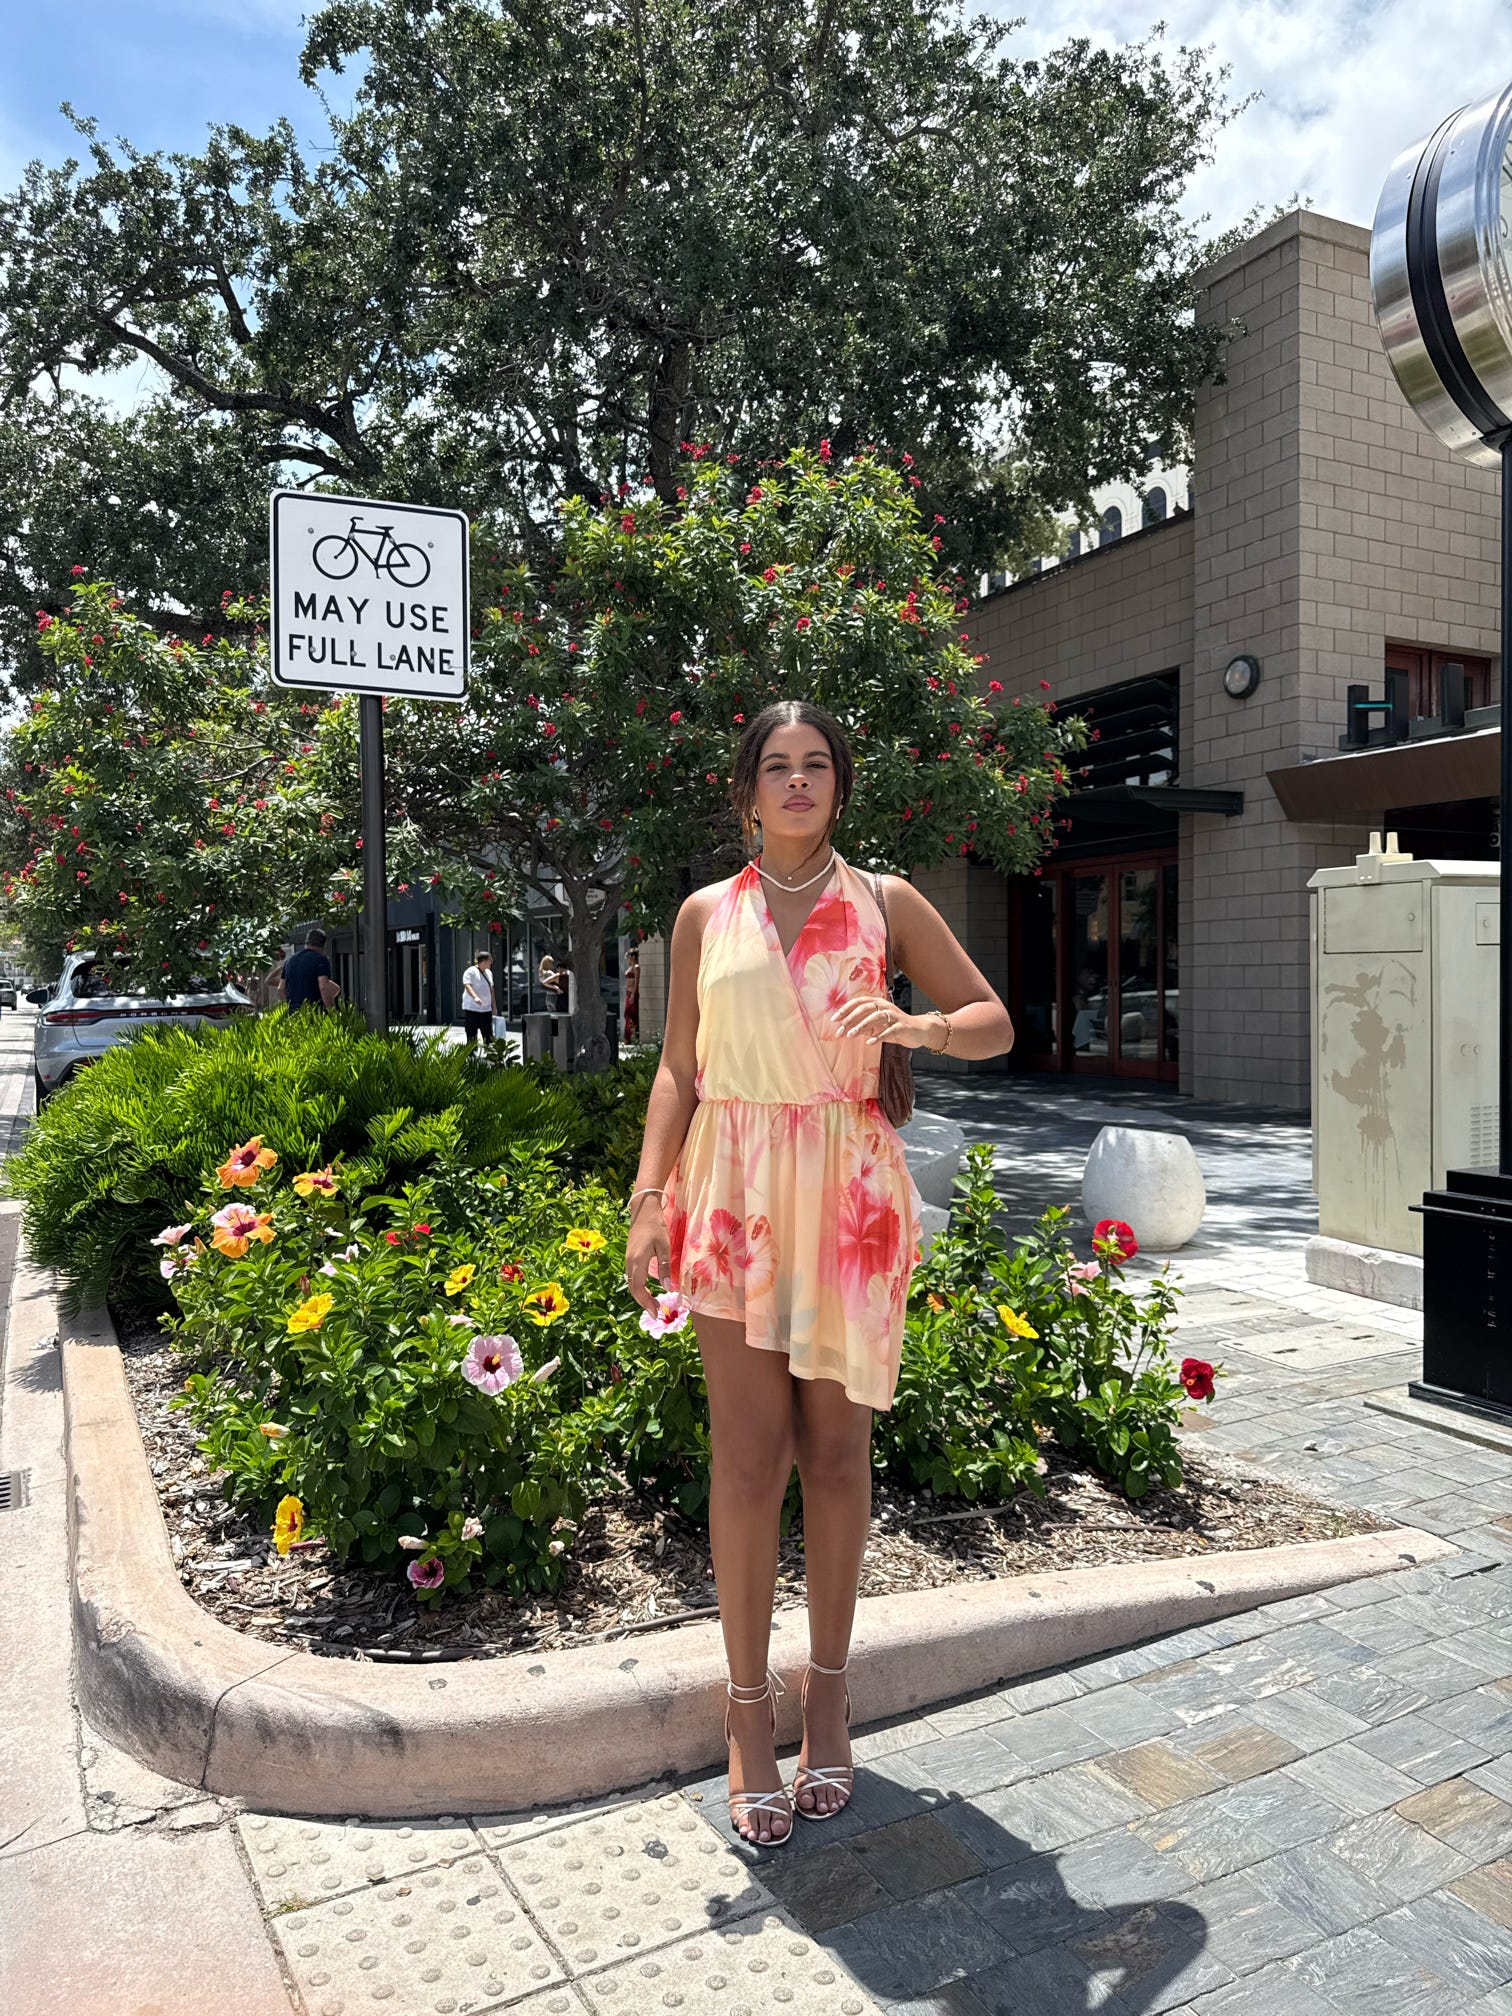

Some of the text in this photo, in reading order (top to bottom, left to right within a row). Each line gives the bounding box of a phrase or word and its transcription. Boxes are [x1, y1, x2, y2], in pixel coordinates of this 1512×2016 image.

[294, 591, 449, 633] MAY USE
[289, 634, 455, 676] FULL LANE
